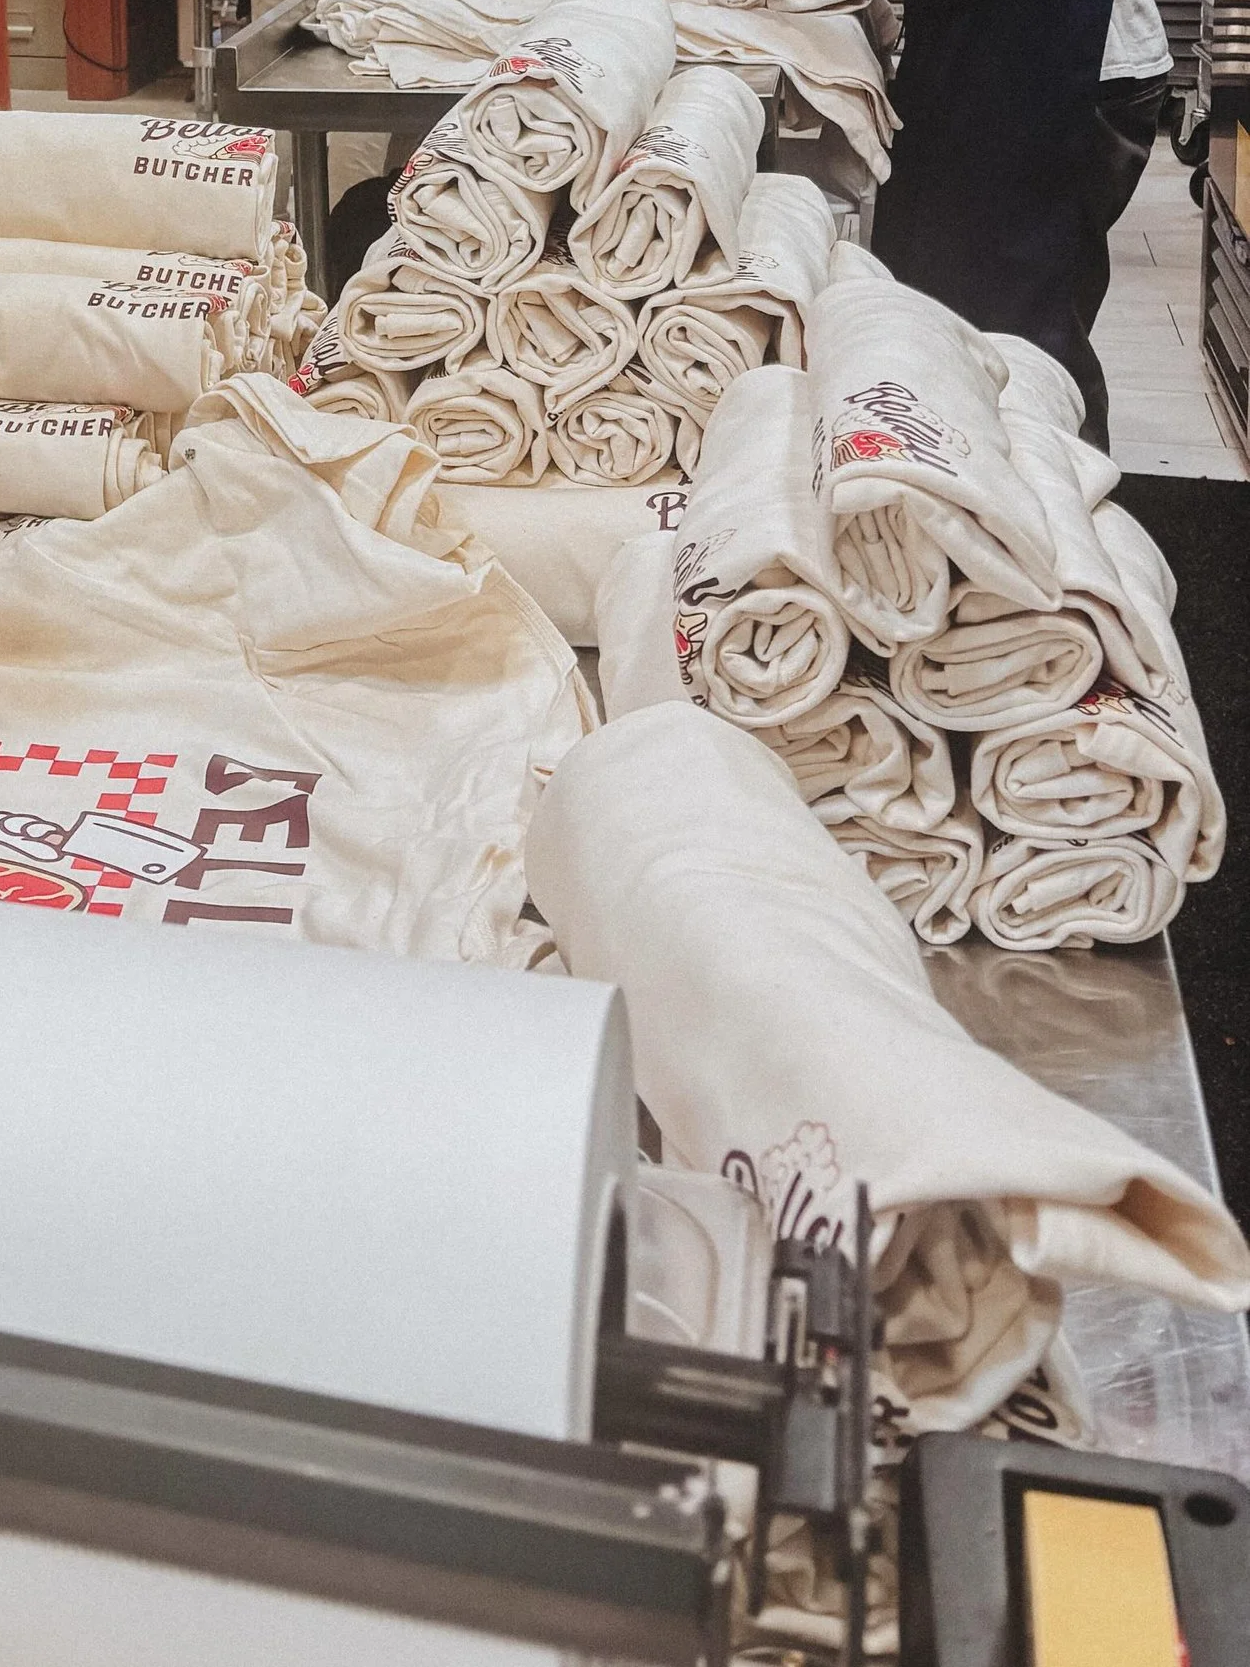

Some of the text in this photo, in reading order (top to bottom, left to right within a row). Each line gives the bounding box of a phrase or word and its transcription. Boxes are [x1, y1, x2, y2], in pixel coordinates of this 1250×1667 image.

[134, 156, 254, 187] BUTCHER
[137, 264, 243, 295] BUTCHE
[87, 291, 212, 321] BUTCHER
